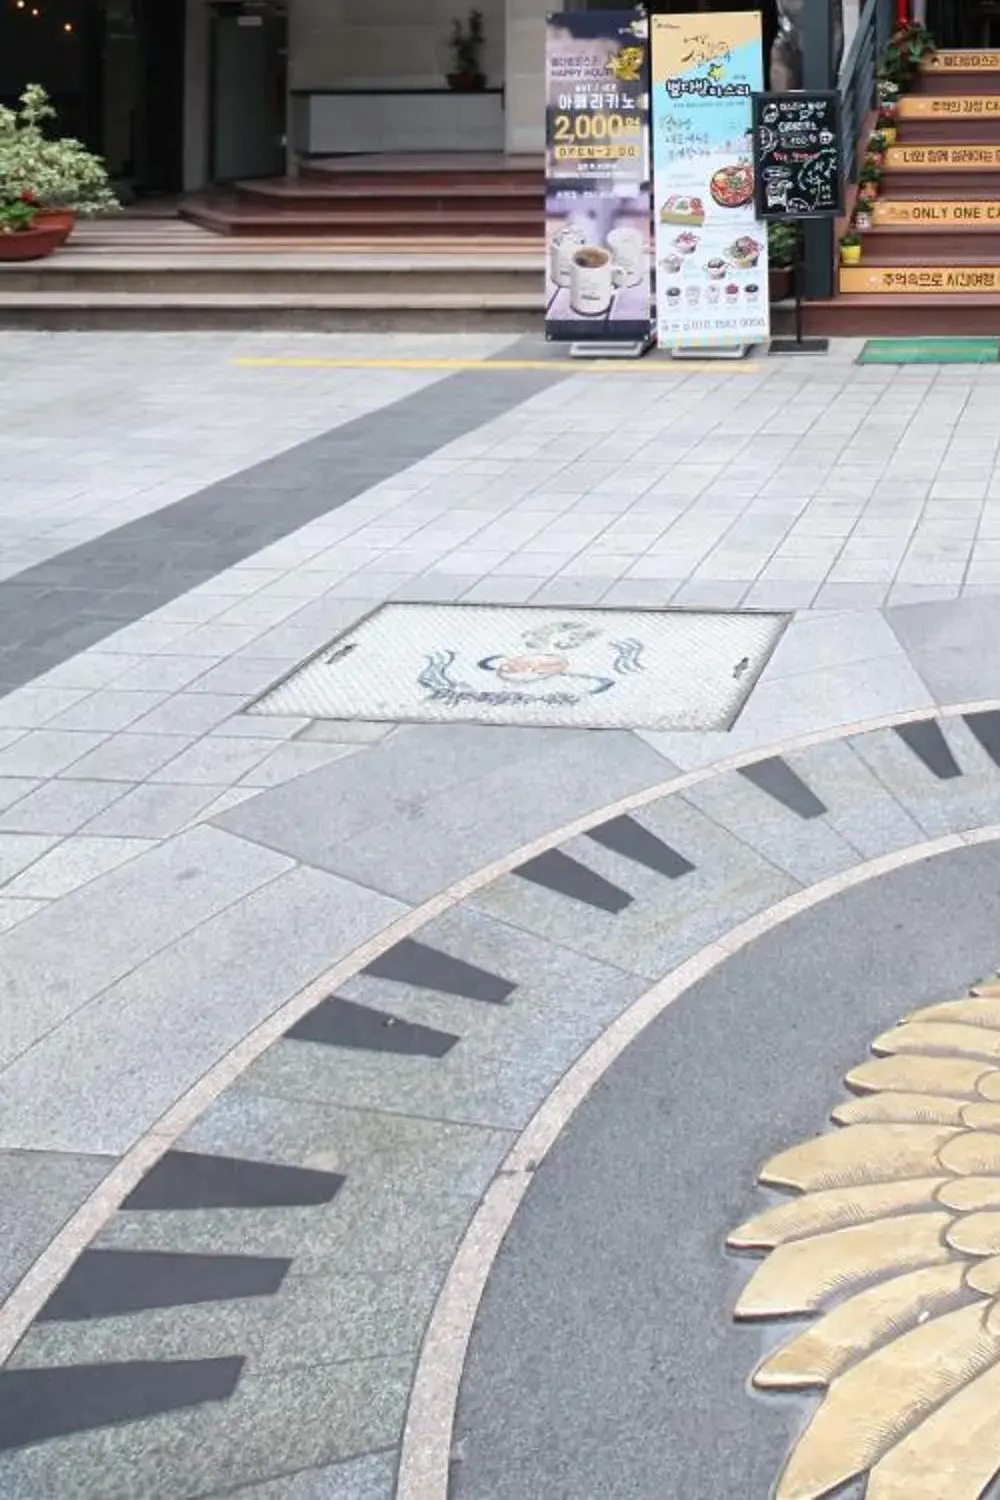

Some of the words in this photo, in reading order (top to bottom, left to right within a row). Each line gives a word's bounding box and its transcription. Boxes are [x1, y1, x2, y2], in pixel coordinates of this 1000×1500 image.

[912, 206, 949, 219] ONLY
[953, 206, 980, 219] ONE
[883, 273, 944, 287] 추억속으로
[945, 272, 995, 286] 시간여행
